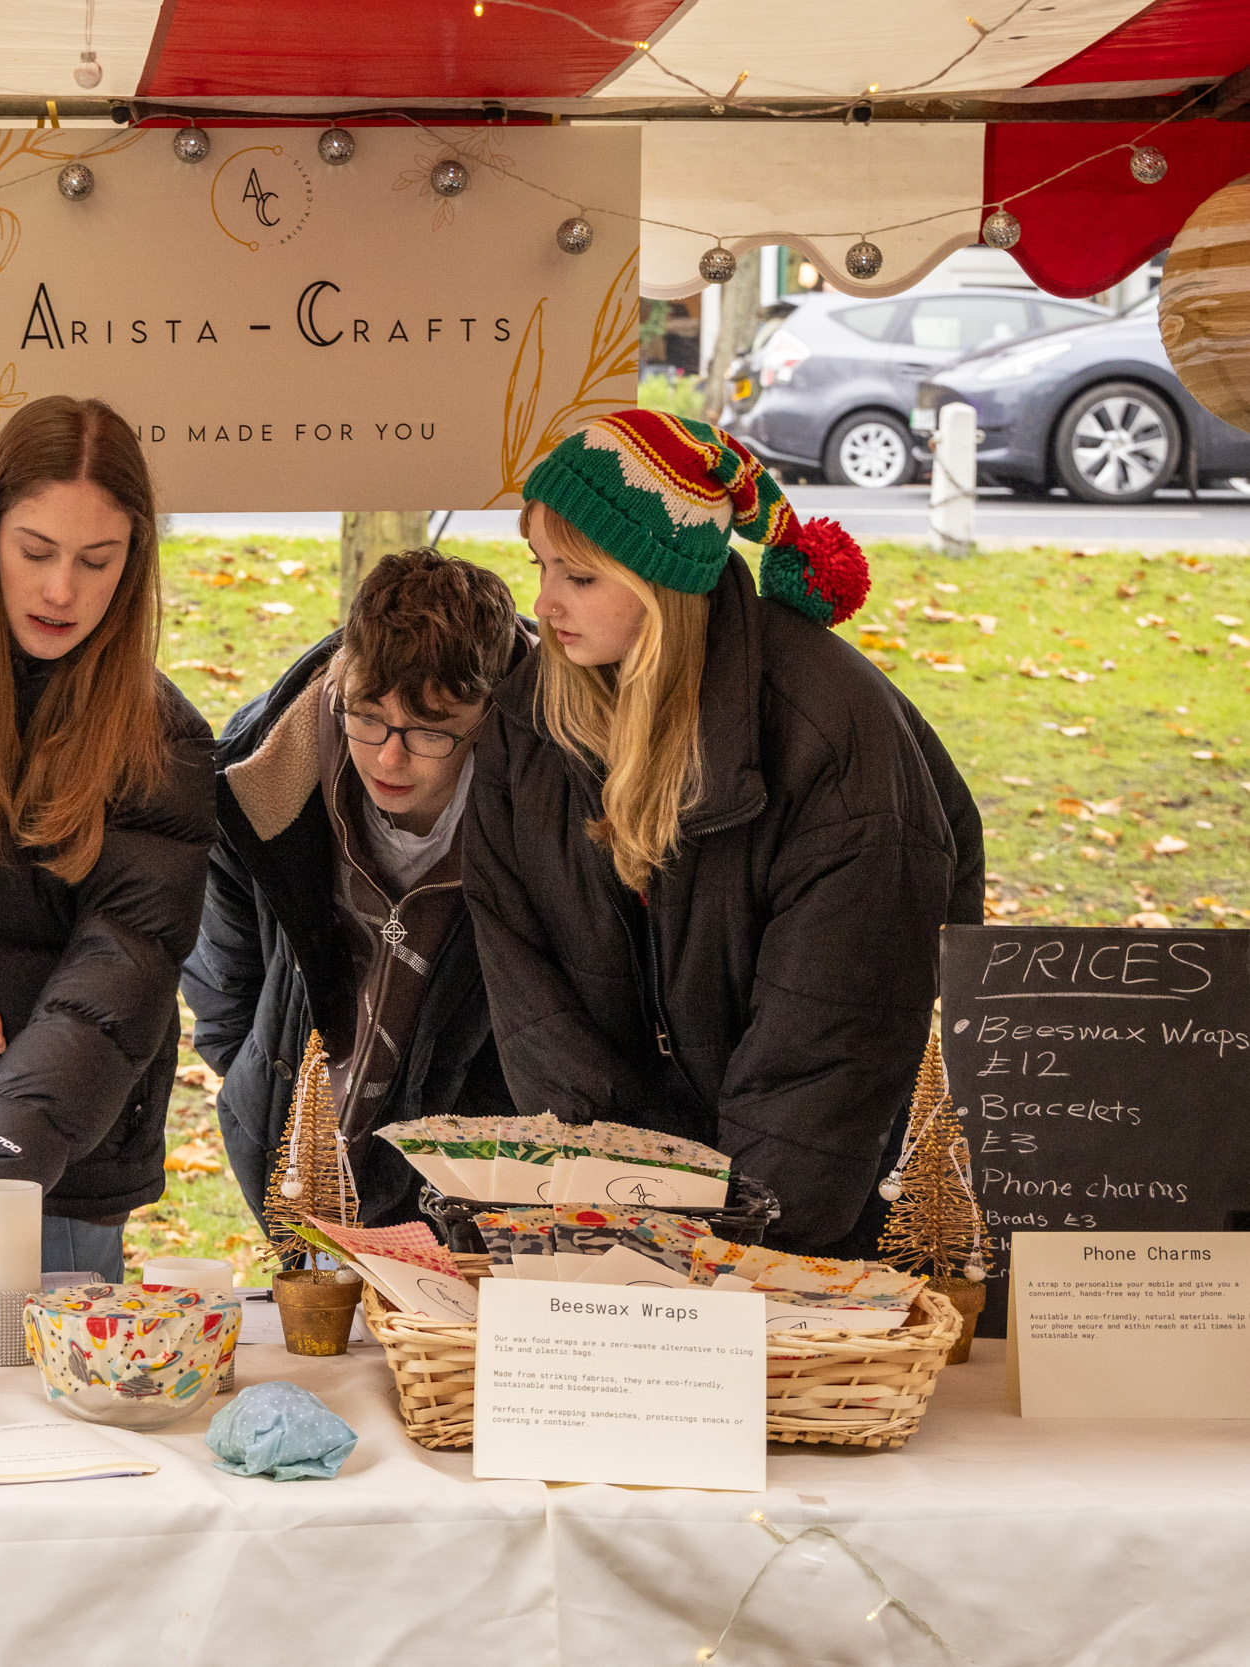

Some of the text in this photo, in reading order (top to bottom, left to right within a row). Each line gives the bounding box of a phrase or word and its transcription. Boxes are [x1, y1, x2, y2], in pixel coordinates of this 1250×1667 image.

[188, 423, 273, 443] MADE
[295, 423, 354, 442] FOR
[377, 422, 438, 441] YOU
[981, 941, 1212, 993] PRICES
[977, 1015, 1250, 1058] Beeswax Wraps
[976, 1050, 1071, 1077] £12
[980, 1094, 1142, 1126] Bracelets
[980, 1130, 1039, 1154] £3
[981, 1168, 1188, 1203] Phone charms
[986, 1210, 1097, 1229] Beads £3
[1083, 1245, 1211, 1261] Phone Charms
[1028, 1280, 1034, 1288] A
[1037, 1281, 1059, 1289] strap
[1075, 1280, 1123, 1289] personalise
[1147, 1280, 1175, 1288] mobile
[1178, 1280, 1192, 1288] and
[1195, 1281, 1214, 1289] give
[1216, 1281, 1231, 1289] you
[1028, 1290, 1075, 1298] convenient,
[1079, 1289, 1124, 1297] hands-free
[1126, 1291, 1141, 1299] way
[1156, 1289, 1175, 1297] hold
[1178, 1291, 1196, 1299] your
[1200, 1290, 1226, 1298] phone.
[550, 1297, 698, 1323] Beeswax Wraps
[1029, 1312, 1069, 1321] Available
[1085, 1313, 1140, 1322] eco-friendly,
[1145, 1313, 1176, 1321] natural
[1179, 1313, 1223, 1321] materials.
[1227, 1312, 1246, 1322] Help
[1030, 1323, 1048, 1331] your
[1051, 1322, 1074, 1331] phone
[1123, 1322, 1151, 1330] within
[1154, 1322, 1177, 1330] reach
[1192, 1322, 1207, 1330] all
[1031, 1331, 1099, 1341] sustainable way.
[494, 1334, 509, 1342] Our
[532, 1336, 551, 1345] food
[554, 1339, 578, 1347] wraps
[609, 1342, 657, 1350] zero-waste
[660, 1343, 712, 1354] alternative
[729, 1347, 754, 1357] cling
[494, 1344, 596, 1358] film and plastic bags.
[493, 1369, 724, 1390] Made from striking fabrics, they are eco-friendly,
[493, 1381, 632, 1394] sustainable and biodegradable.
[492, 1405, 526, 1414] Perfect
[530, 1406, 544, 1415] for
[548, 1409, 586, 1419] wrapping
[590, 1410, 641, 1421] sandwiches,
[645, 1414, 698, 1424] protectings
[702, 1416, 730, 1425] snacks
[492, 1416, 530, 1426] covering
[543, 1419, 590, 1428] container.
